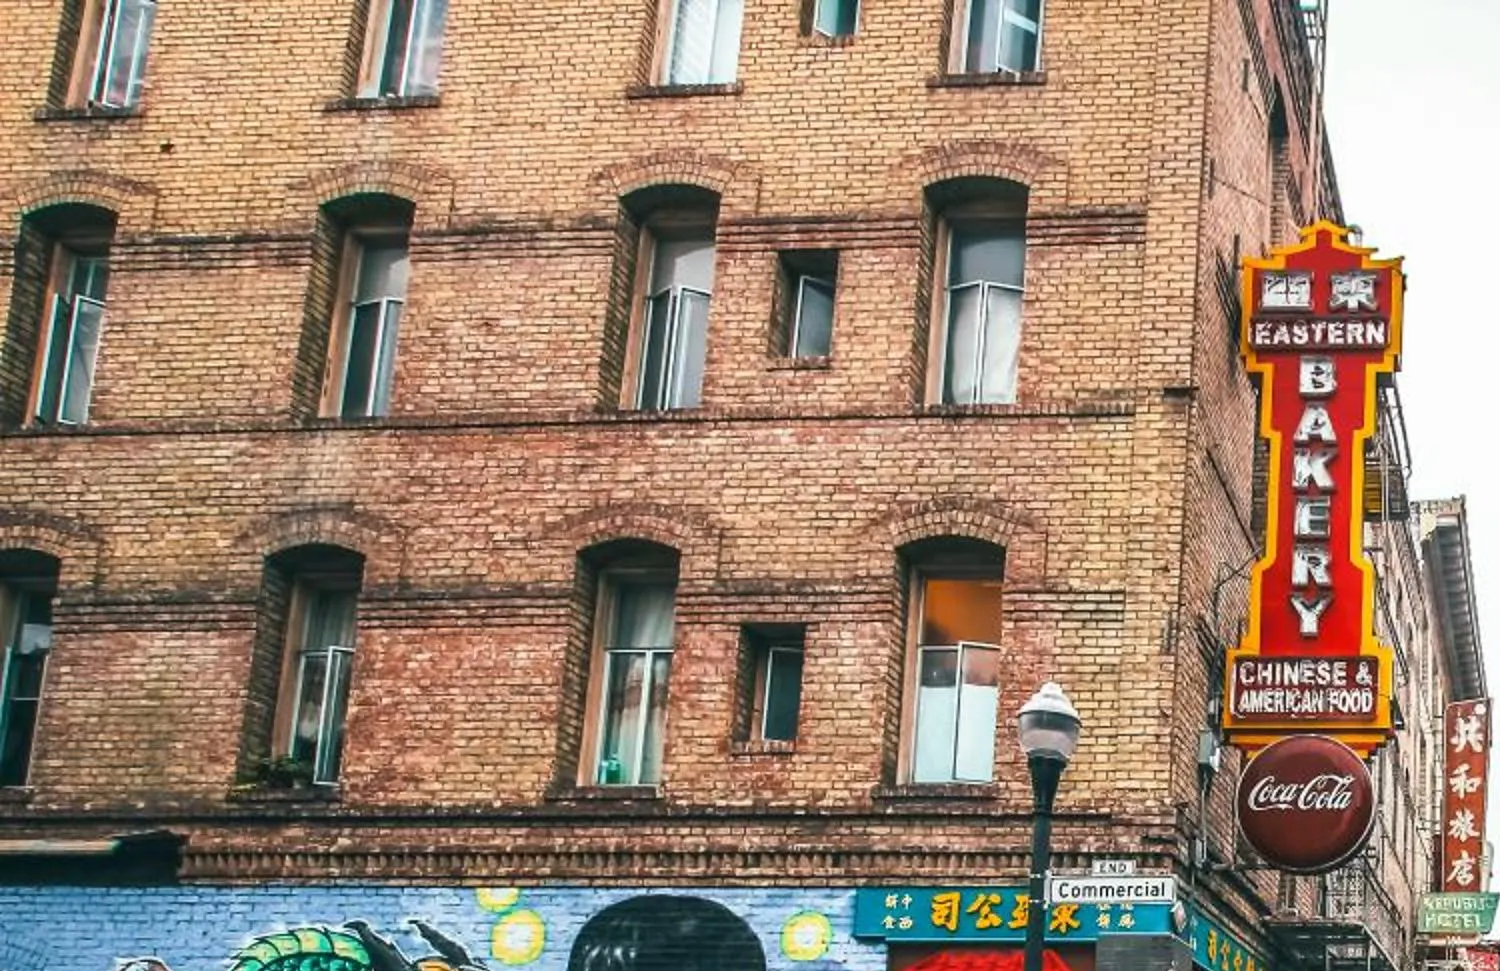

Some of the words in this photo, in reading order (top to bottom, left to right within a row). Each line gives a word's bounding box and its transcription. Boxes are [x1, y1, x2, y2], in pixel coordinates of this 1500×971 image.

[1255, 321, 1385, 345] EASTERN
[1291, 357, 1337, 636] BAKERY
[1239, 661, 1348, 685] CHINESE
[1355, 661, 1373, 685] &
[1239, 689, 1324, 714] AMERICAN
[1328, 689, 1373, 713] FOOD
[1248, 775, 1355, 811] Coca-Cola
[1100, 863, 1127, 873] END
[1059, 882, 1165, 899] Commercial
[1425, 913, 1485, 929] HOTEL
